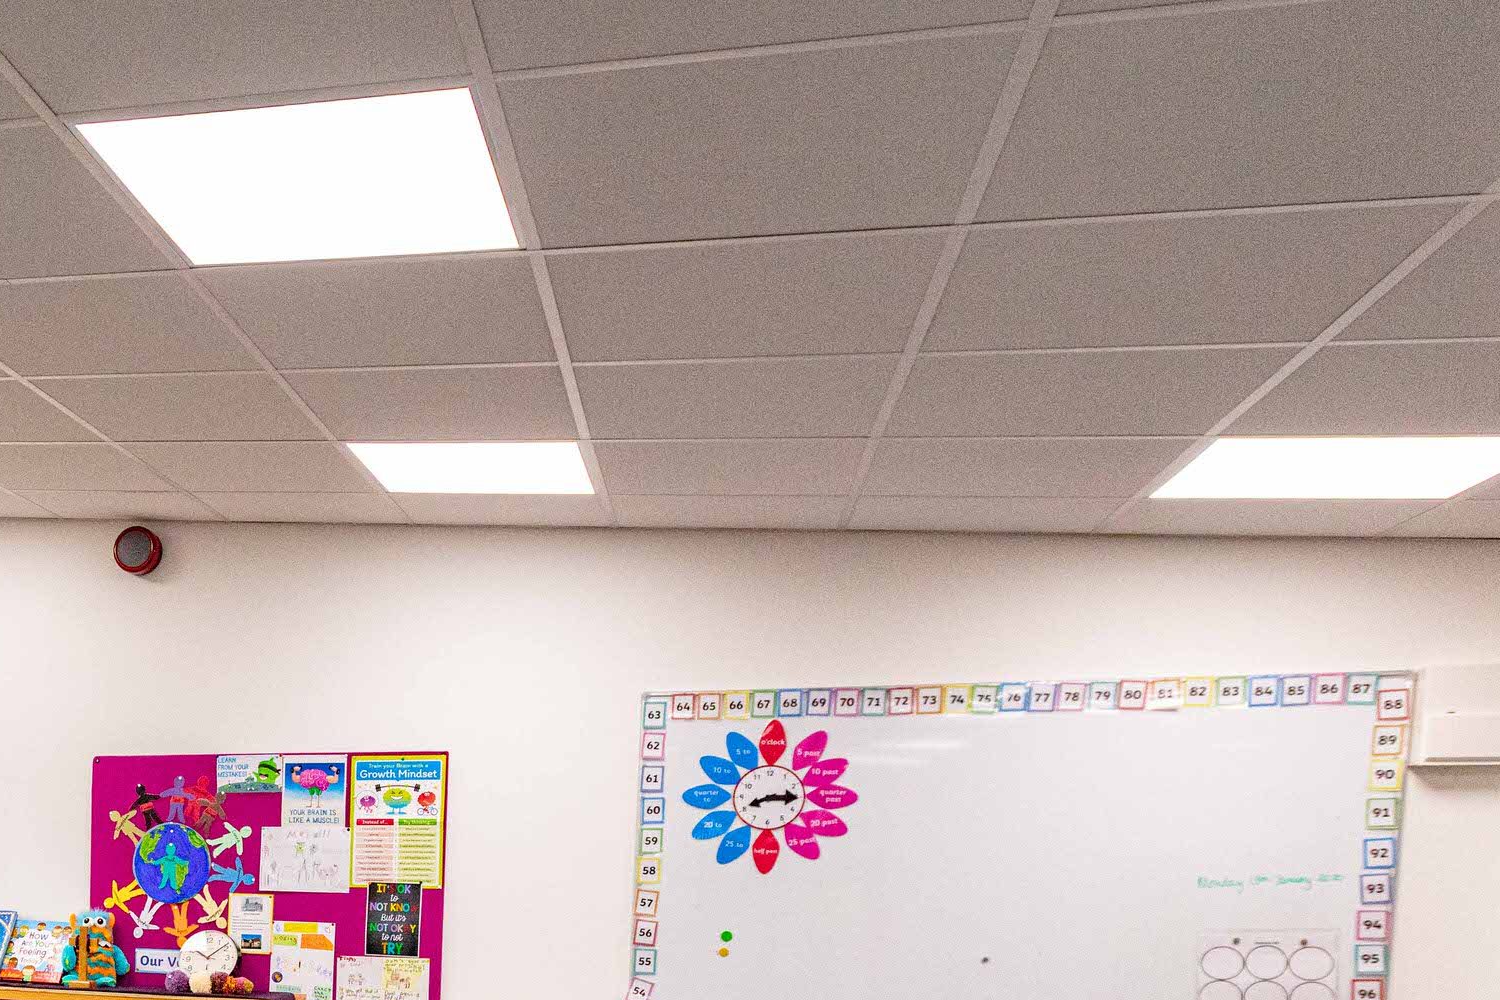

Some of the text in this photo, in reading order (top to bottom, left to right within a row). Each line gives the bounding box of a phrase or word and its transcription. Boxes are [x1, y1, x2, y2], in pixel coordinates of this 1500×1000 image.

[1157, 688, 1173, 699] 81
[1189, 686, 1207, 697] 82
[1221, 686, 1240, 697] 83
[1254, 686, 1273, 697] 84
[1286, 685, 1305, 696] 85
[1320, 683, 1339, 695] 86
[1352, 683, 1371, 694] 87
[950, 694, 965, 704] 74
[976, 694, 992, 703] 75
[1034, 692, 1051, 703] 77
[1064, 691, 1080, 702] 78
[1094, 690, 1112, 700] 79
[1123, 689, 1142, 700] 80
[729, 700, 744, 710] 66
[756, 699, 771, 709] 67
[782, 698, 798, 708] 68
[811, 697, 827, 708] 69
[839, 697, 855, 707] 70
[866, 697, 881, 707] 71
[893, 696, 909, 706] 72
[922, 695, 937, 705] 73
[1384, 699, 1403, 710] 88
[676, 702, 691, 712] 64
[702, 701, 716, 711] 65
[647, 710, 661, 720] 63
[1378, 735, 1397, 746] 89
[646, 741, 660, 751] 62
[360, 769, 437, 779] Growth Mindset
[822, 768, 839, 776] past
[1376, 769, 1395, 780] 90
[645, 774, 659, 783] 61
[646, 805, 661, 815] 60
[1372, 807, 1390, 818] 91
[823, 818, 838, 827] past
[644, 836, 658, 846] 59
[789, 838, 798, 846] 25
[1370, 847, 1389, 859] 92
[642, 866, 656, 875] 58
[377, 883, 411, 894] IT'S OK
[1366, 883, 1385, 894] 93
[390, 894, 399, 902] to
[639, 898, 654, 908] 57
[369, 902, 388, 911] NOT
[369, 923, 416, 934] NOT OKAY
[1363, 919, 1382, 930] 94
[638, 927, 653, 938] 56
[20, 948, 47, 958] Feeling
[381, 942, 404, 955] TRY
[140, 955, 164, 967] Our
[638, 956, 652, 966] 55
[1361, 953, 1380, 964] 95
[633, 987, 646, 997] 54
[1357, 989, 1376, 999] 96
